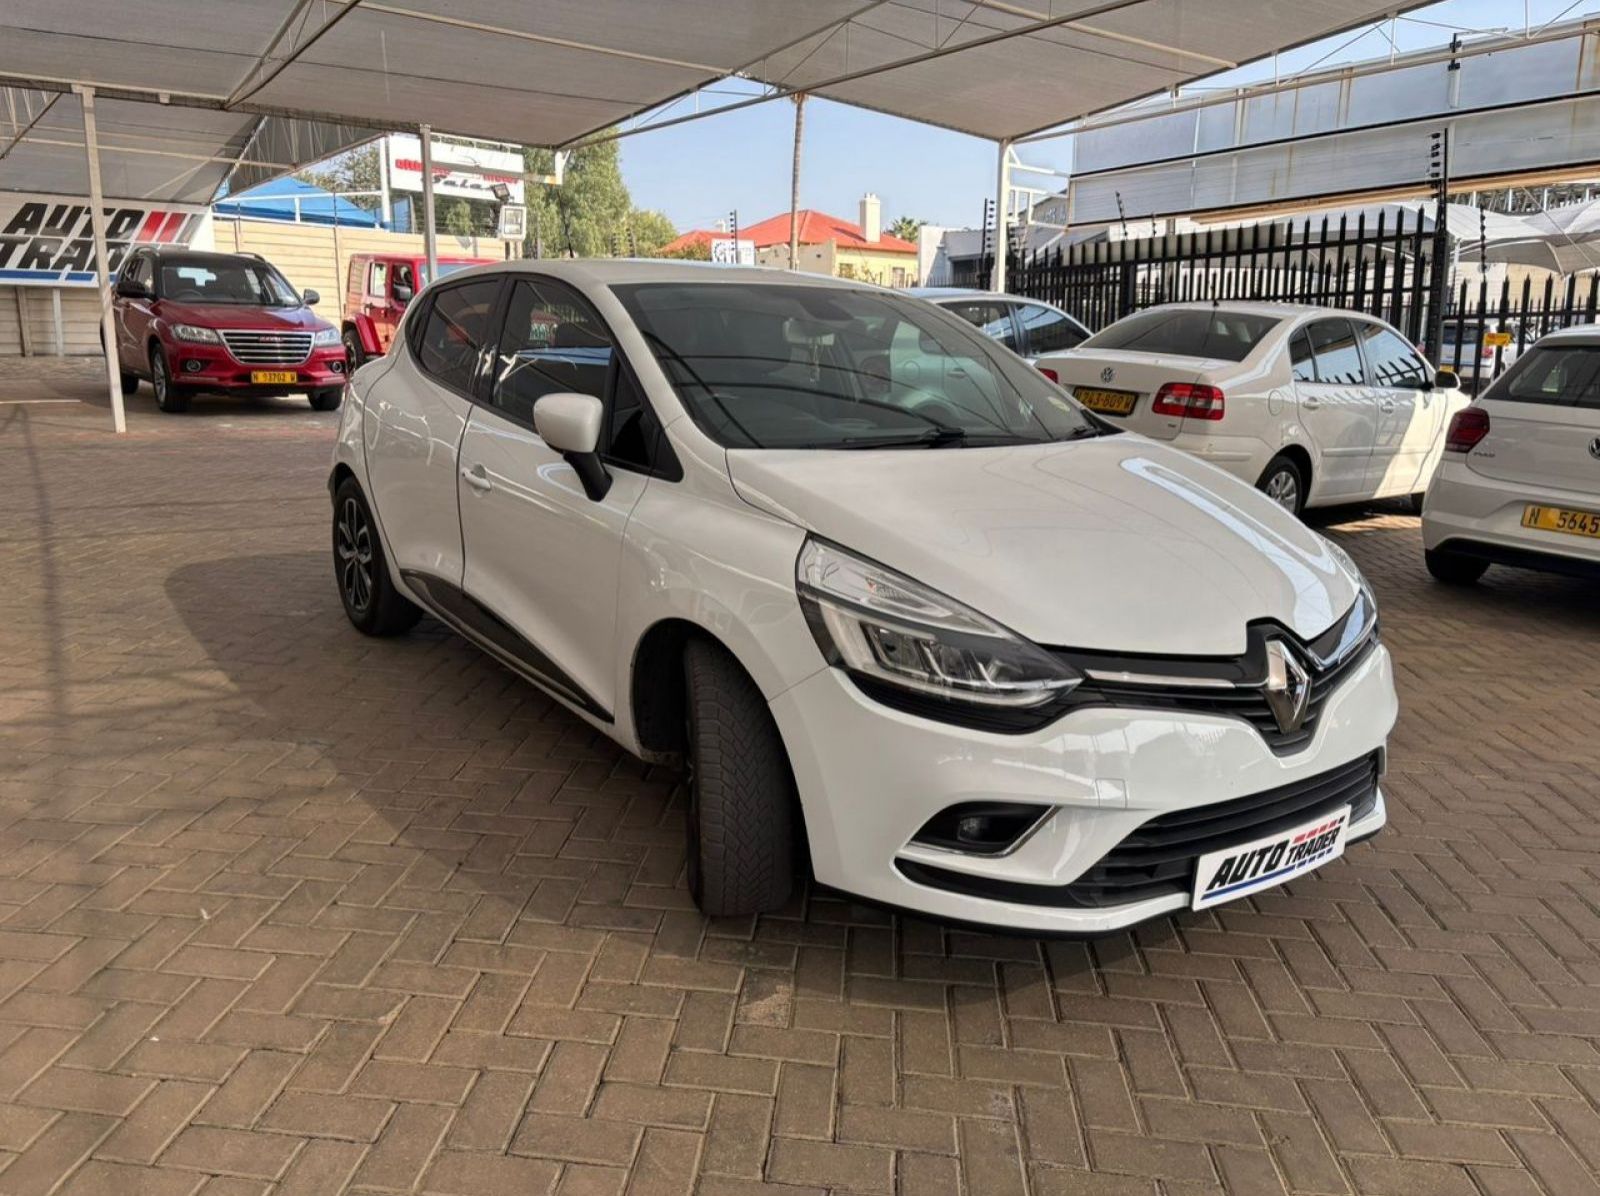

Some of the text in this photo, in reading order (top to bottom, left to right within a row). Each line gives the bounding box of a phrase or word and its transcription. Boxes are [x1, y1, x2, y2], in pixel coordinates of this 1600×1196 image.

[1, 202, 145, 240] AUTO
[0, 237, 160, 273] TRAD
[1528, 507, 1541, 525] N
[1206, 825, 1342, 892] AUTO TRADER
